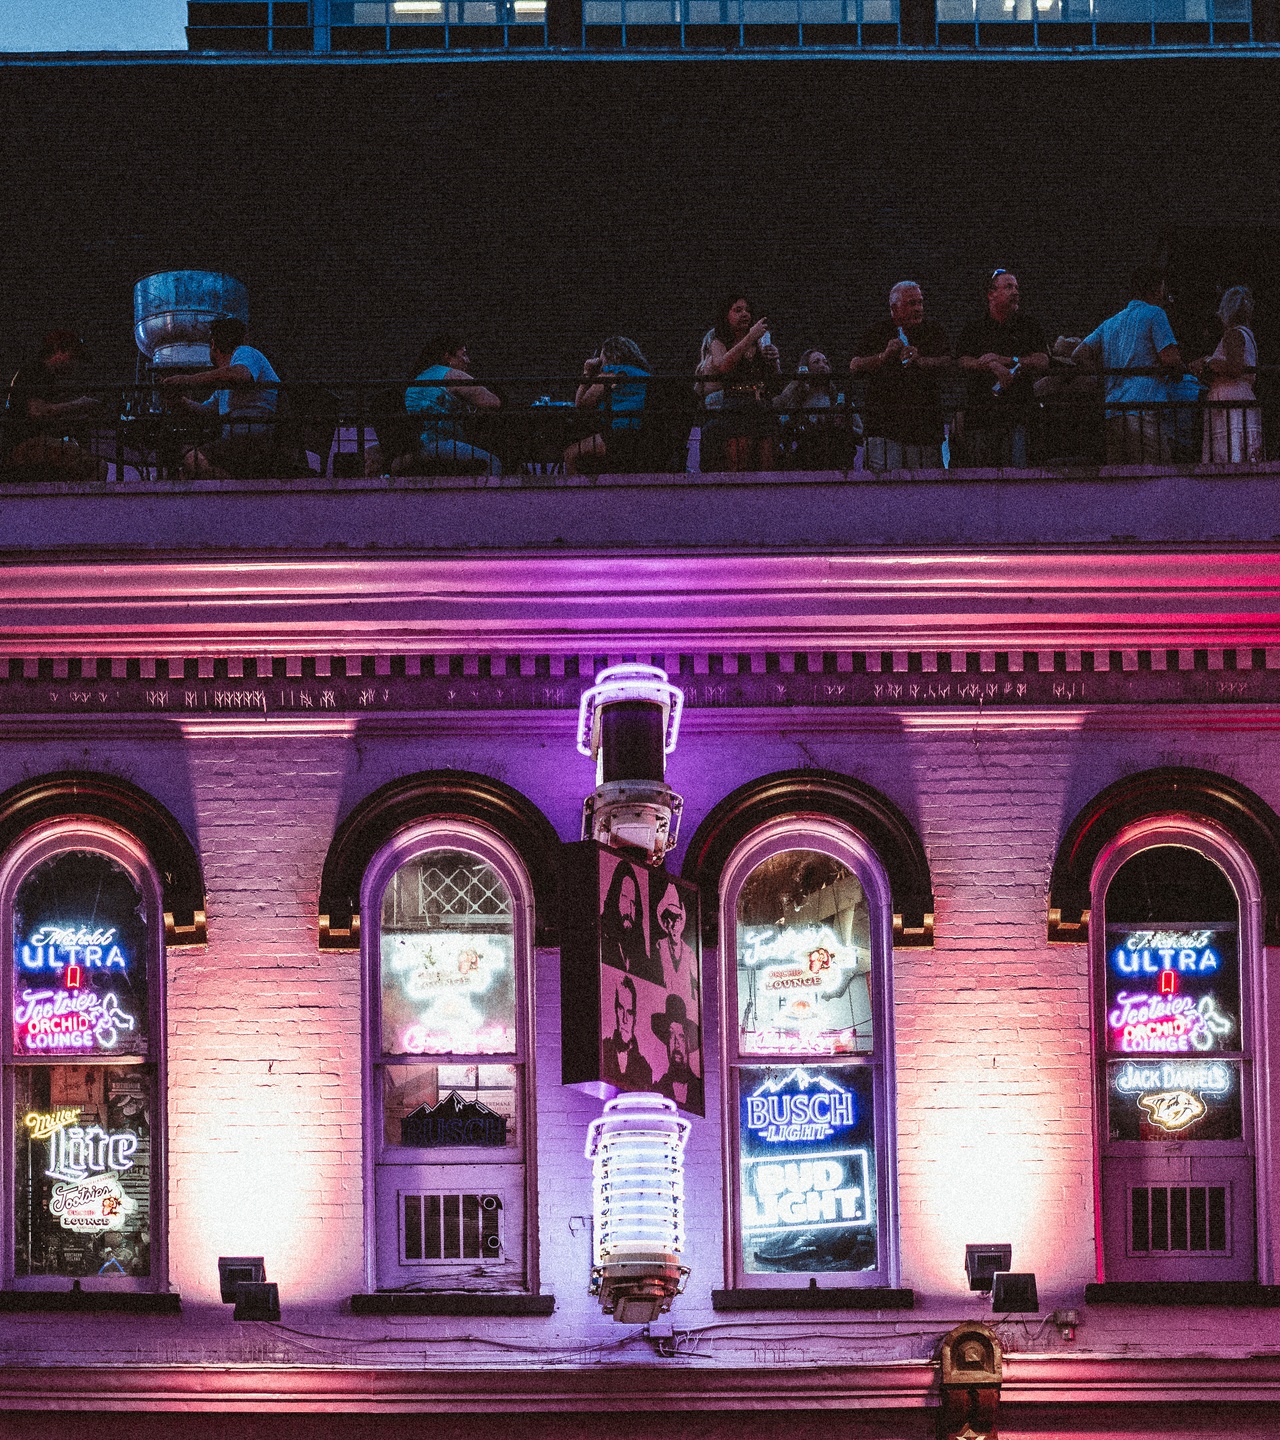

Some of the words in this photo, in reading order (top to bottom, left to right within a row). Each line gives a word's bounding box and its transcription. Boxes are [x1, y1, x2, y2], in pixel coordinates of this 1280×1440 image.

[22, 945, 126, 968] ULTRA
[1117, 949, 1217, 972] ULTRA
[28, 1016, 88, 1034] ORCHID
[1124, 1018, 1185, 1040] ORCHID
[26, 1030, 94, 1048] LOUNGE
[1122, 1035, 1188, 1051] LOUNGE
[1121, 1066, 1160, 1089] JACK
[747, 1093, 854, 1128] BUSCH
[25, 1109, 81, 1138] Miller
[45, 1125, 138, 1181] Lite
[756, 1161, 843, 1197] BUD
